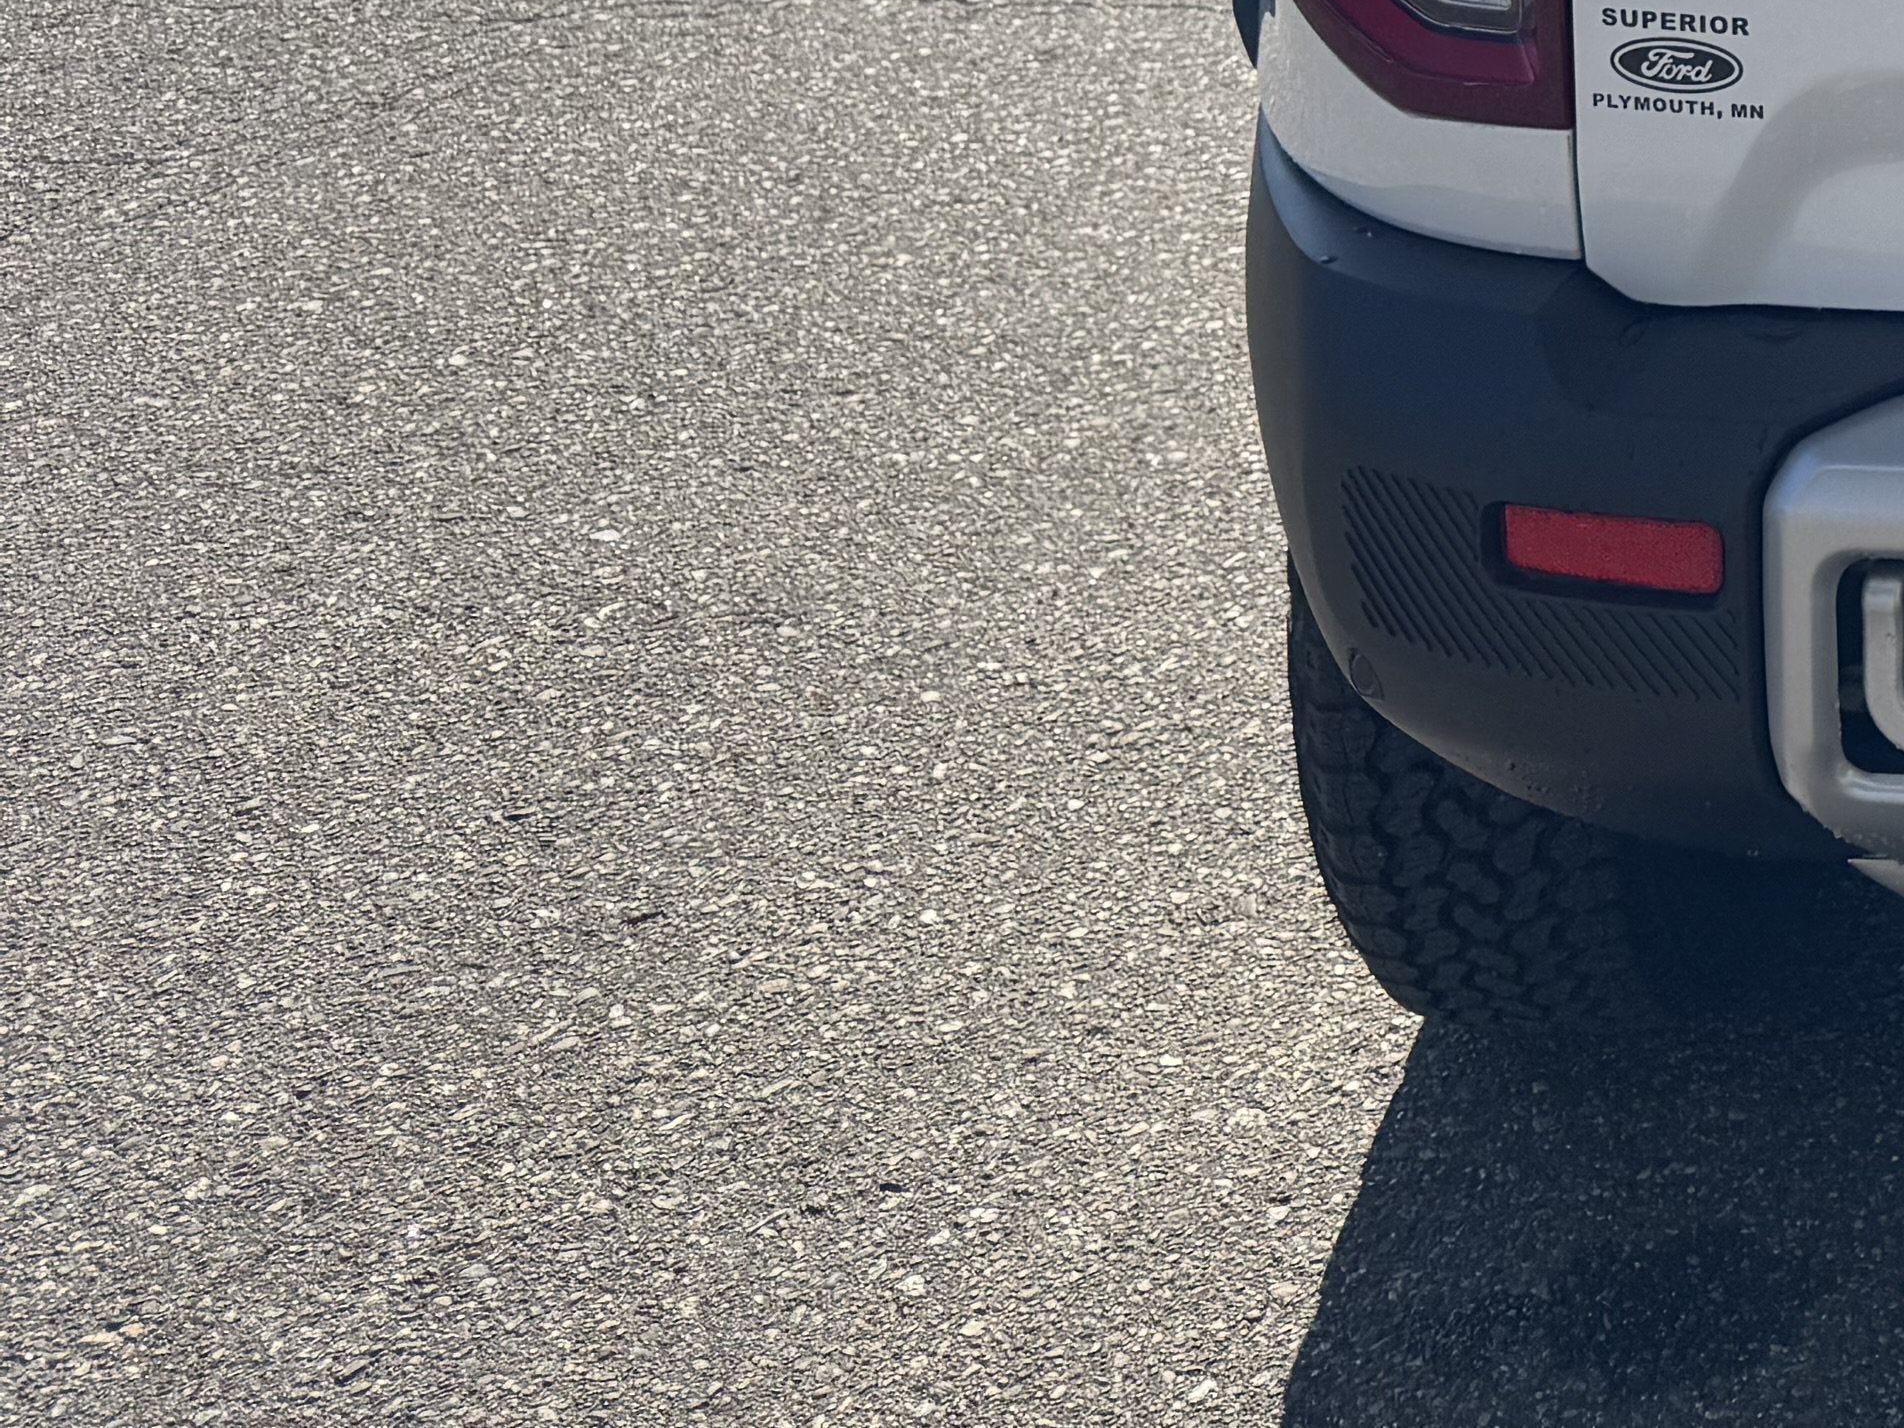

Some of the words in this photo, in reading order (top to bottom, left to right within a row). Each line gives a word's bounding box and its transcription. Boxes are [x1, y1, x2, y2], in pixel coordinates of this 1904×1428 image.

[1601, 7, 1751, 37] SUPERIOR
[1639, 46, 1713, 83] Ford
[1591, 92, 1724, 120] PLYMOUTH,
[1730, 102, 1765, 120] MN
